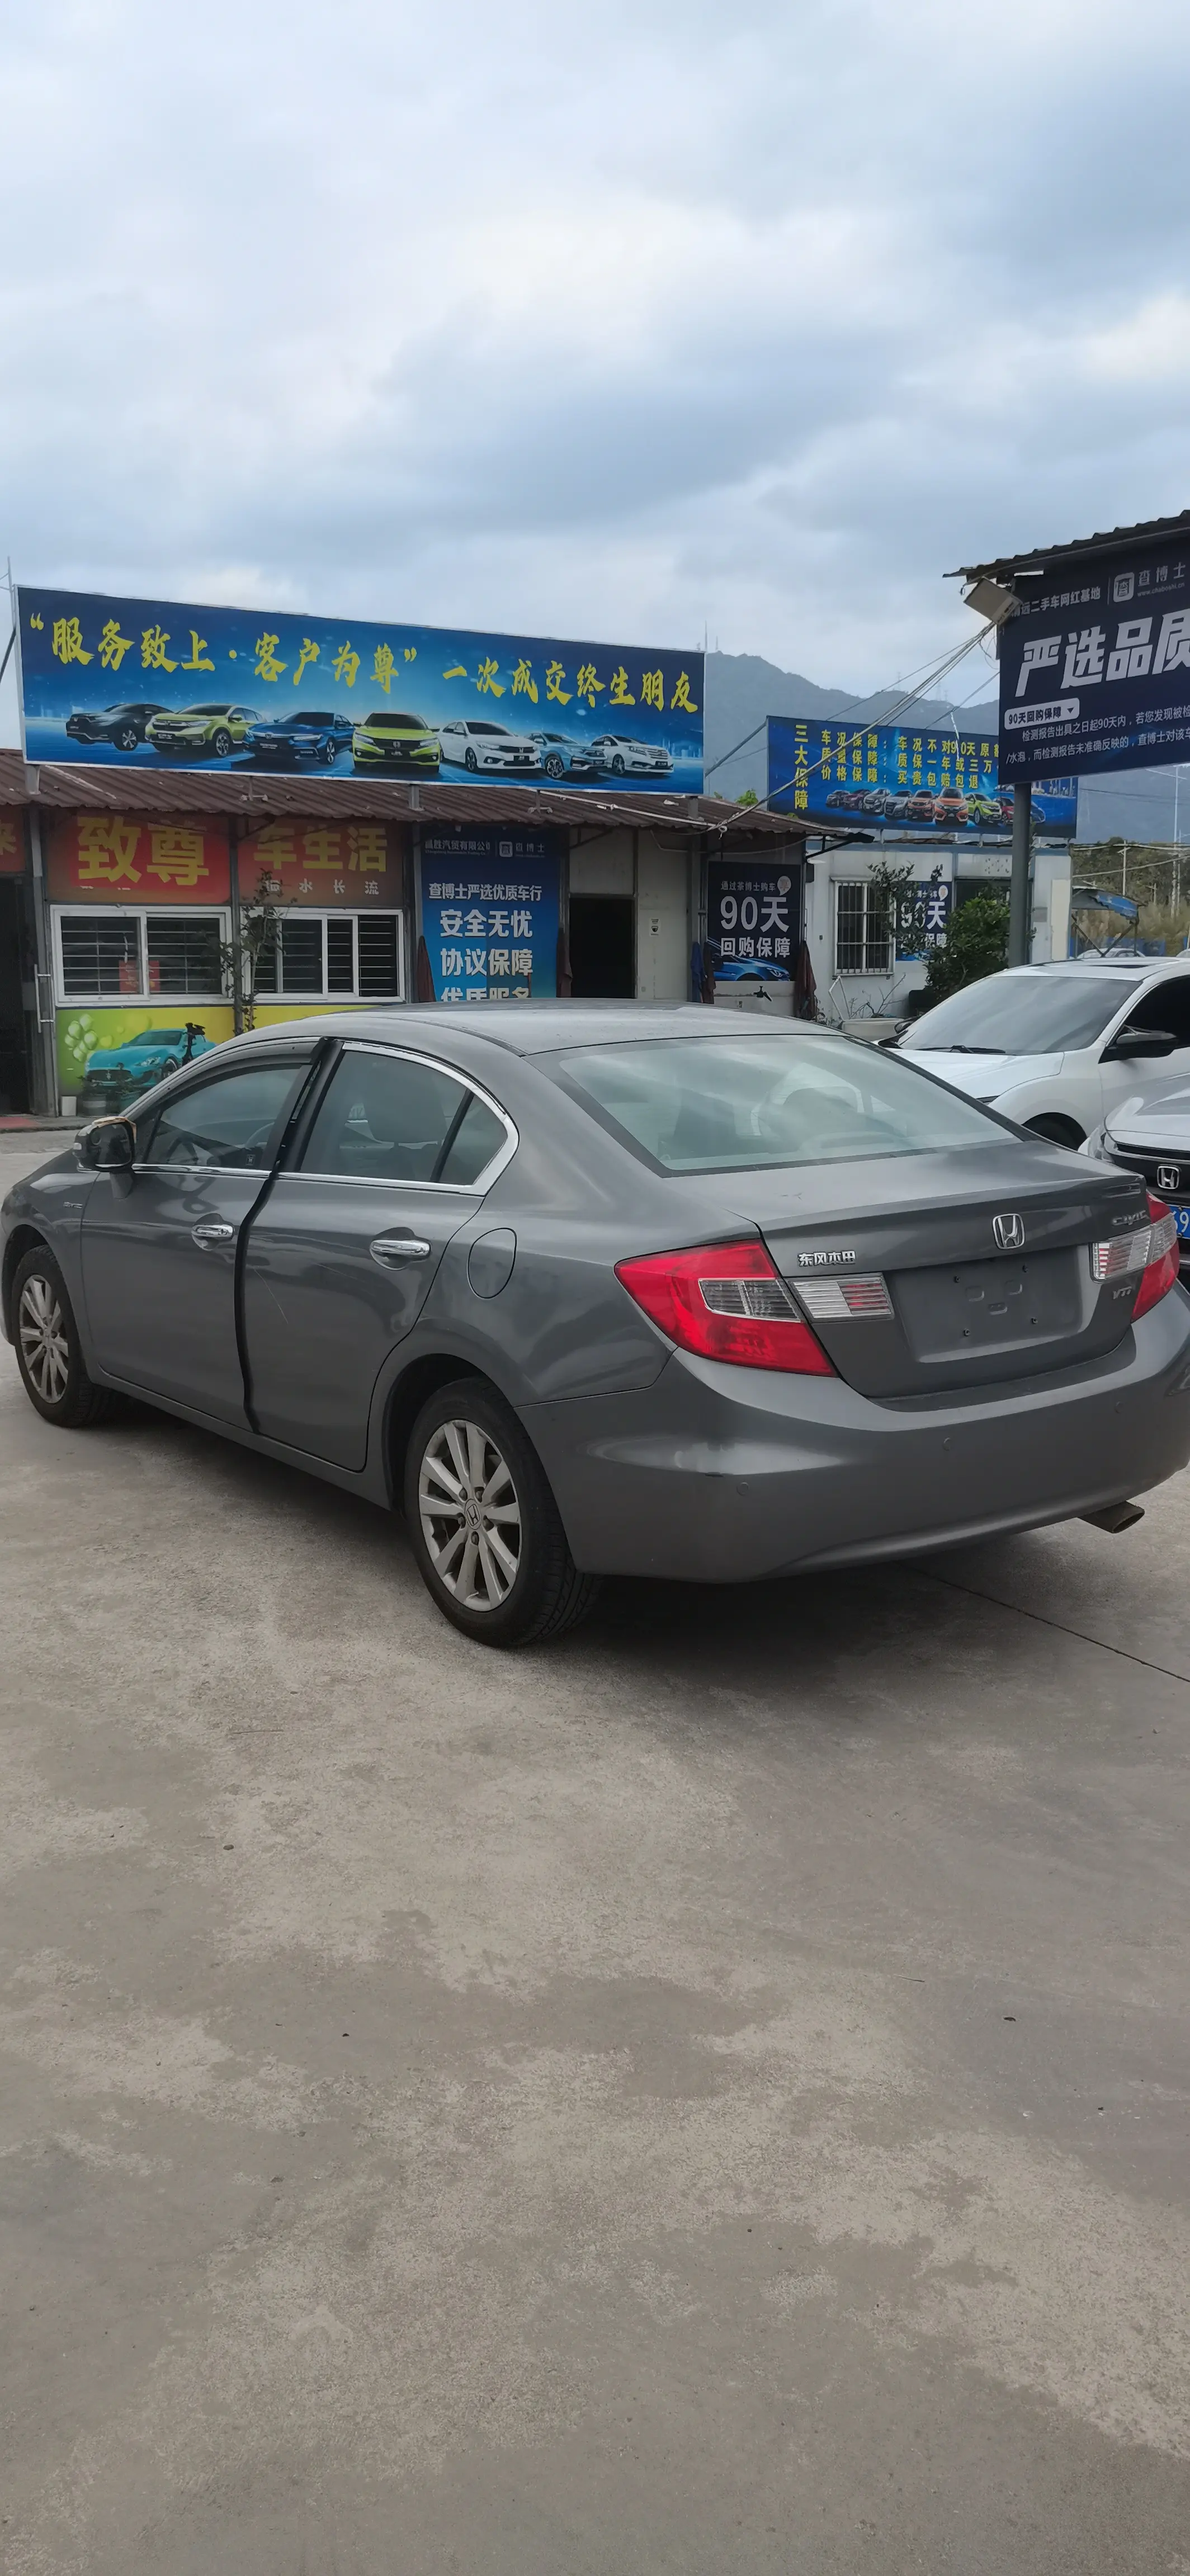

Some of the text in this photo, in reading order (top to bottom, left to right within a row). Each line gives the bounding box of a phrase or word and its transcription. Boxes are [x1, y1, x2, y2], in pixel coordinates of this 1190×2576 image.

[442, 656, 698, 713] 一次成交终生朋友
[1008, 706, 1062, 725] 90天回购保障
[794, 724, 809, 811] 三大保障
[77, 816, 209, 886] 致尊
[253, 824, 388, 872] 车生活
[428, 883, 542, 901] 查博士严选优质车行
[440, 909, 533, 938] 安全无忧
[720, 896, 789, 932] 90天
[720, 936, 791, 958] 回购保障
[440, 948, 533, 976] 协议保障
[1112, 1209, 1146, 1226] CIVIC
[798, 1251, 856, 1267] 东风本田
